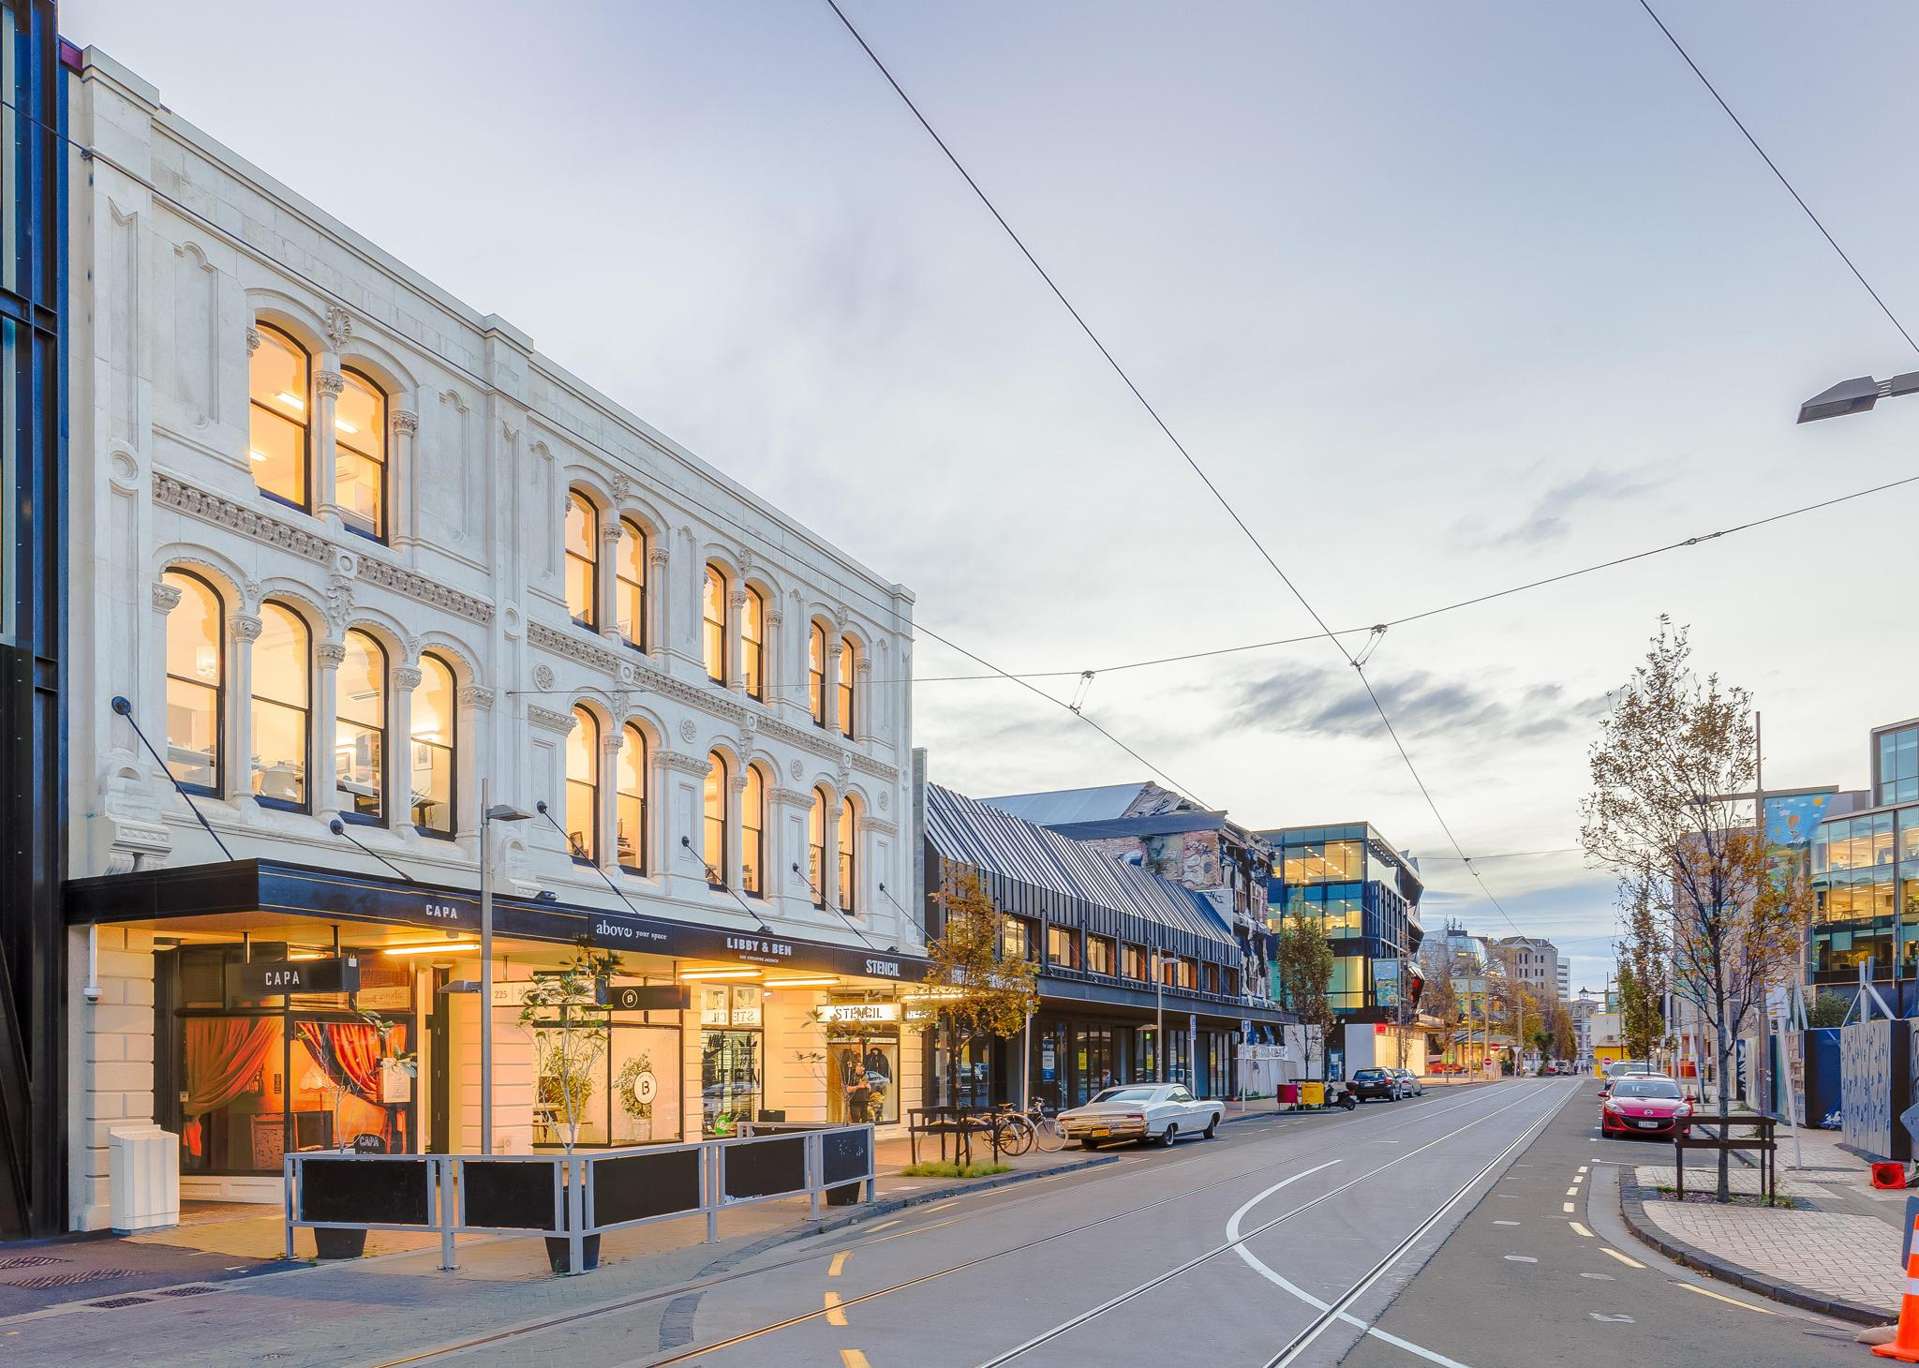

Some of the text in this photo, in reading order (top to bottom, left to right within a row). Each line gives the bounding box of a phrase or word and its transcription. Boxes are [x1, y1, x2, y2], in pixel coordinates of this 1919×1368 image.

[425, 904, 458, 919] CAPA
[596, 919, 668, 941] above your space
[726, 937, 792, 956] LIBBY & BEN
[865, 959, 901, 977] STENCIL
[265, 971, 300, 986] CAPA
[494, 990, 508, 999] 225
[641, 1080, 650, 1096] B
